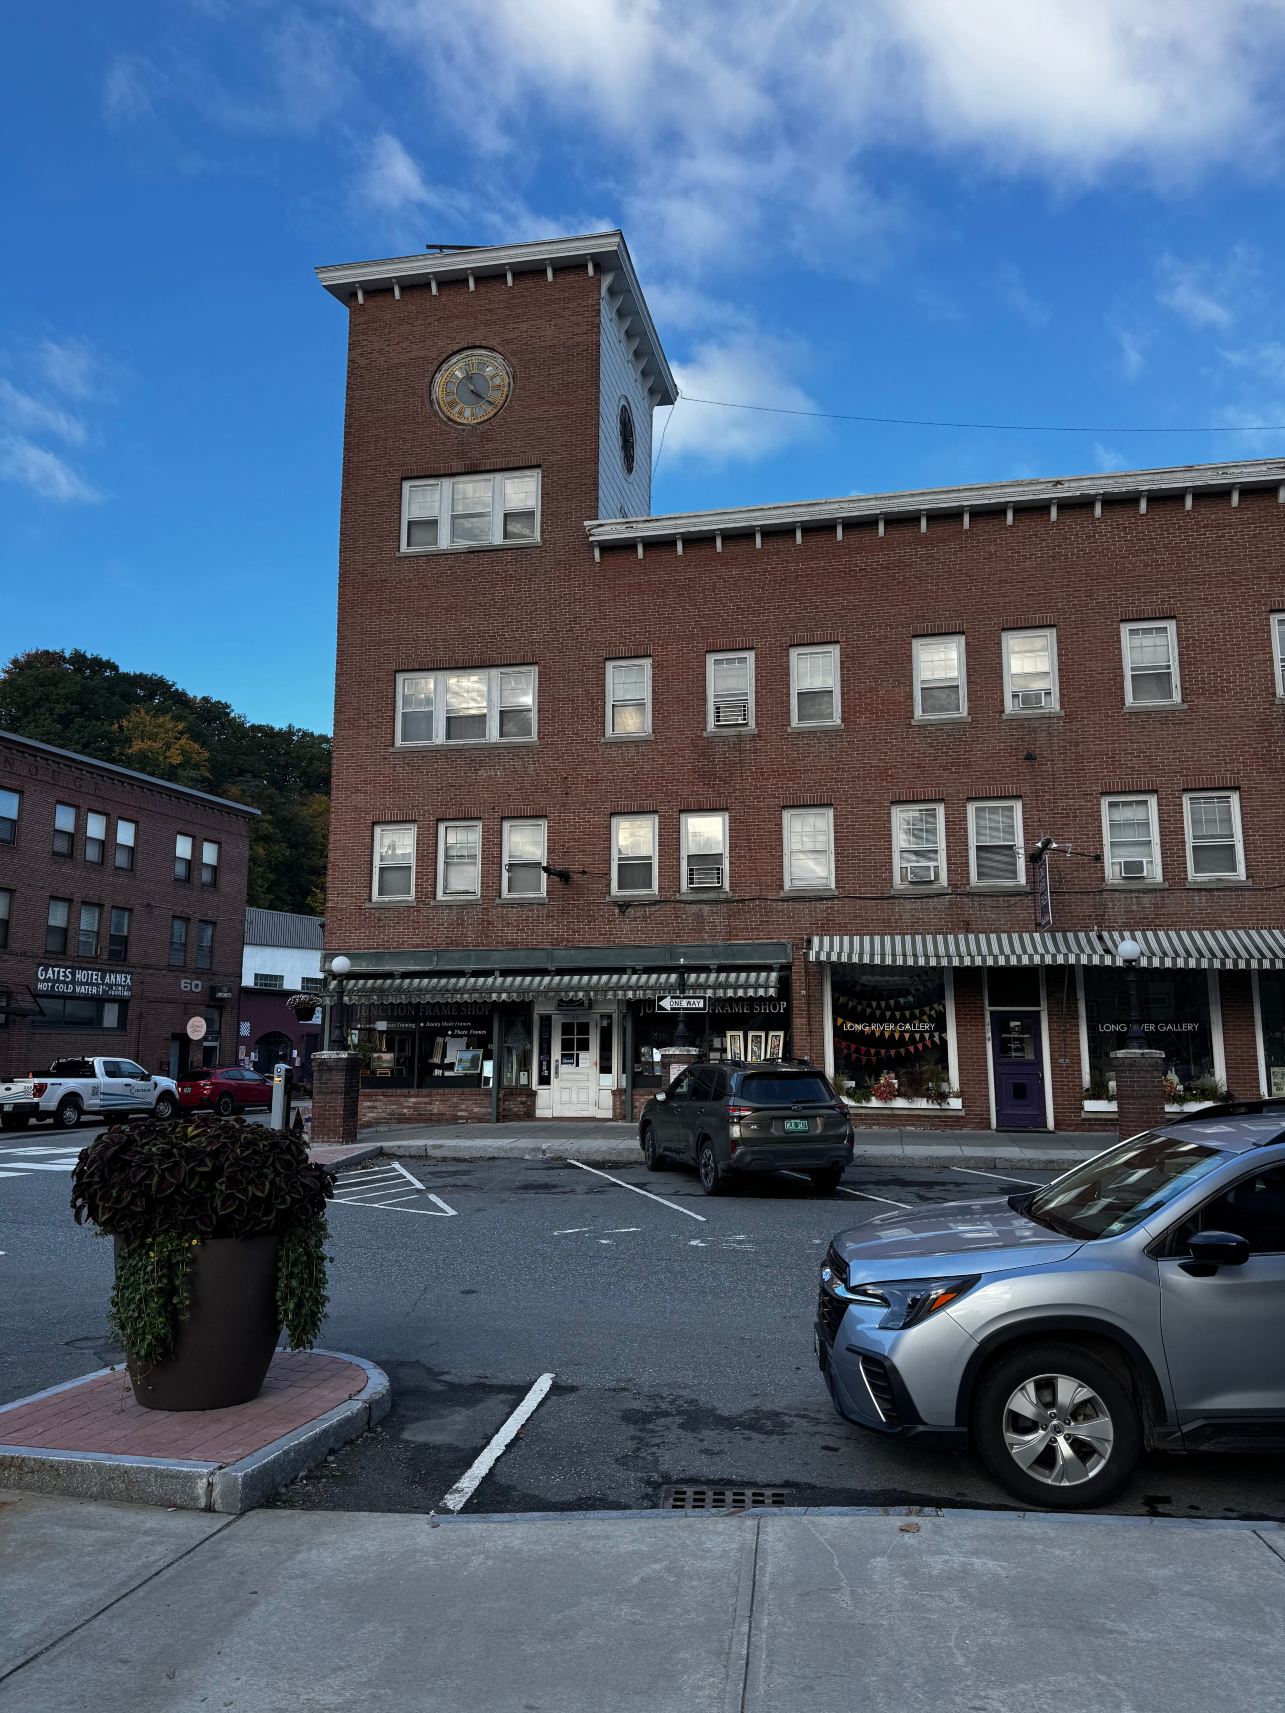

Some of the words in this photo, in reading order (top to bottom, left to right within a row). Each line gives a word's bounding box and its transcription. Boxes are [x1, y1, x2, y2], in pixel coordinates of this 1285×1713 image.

[37, 966, 72, 981] GATES
[75, 969, 103, 983] HOTEL
[104, 972, 132, 986] ANNEX
[37, 982, 52, 991] HOT
[54, 983, 73, 993] COLD
[75, 985, 97, 995] WATER
[180, 979, 202, 993] 60
[669, 999, 684, 1007] ONE
[686, 999, 702, 1007] WAY
[709, 1002, 750, 1014] FRAME
[753, 1001, 787, 1013] SHOP
[356, 1002, 415, 1018] JUNCTION
[419, 1003, 458, 1016] FRAME
[461, 1003, 492, 1016] SHOP
[843, 1022, 869, 1031] LONG
[871, 1022, 897, 1031] RIVER
[897, 1022, 936, 1031] GALLERY
[1098, 1023, 1127, 1032] LONG
[1129, 1023, 1156, 1032] VER
[1157, 1023, 1199, 1032] GALLERY
